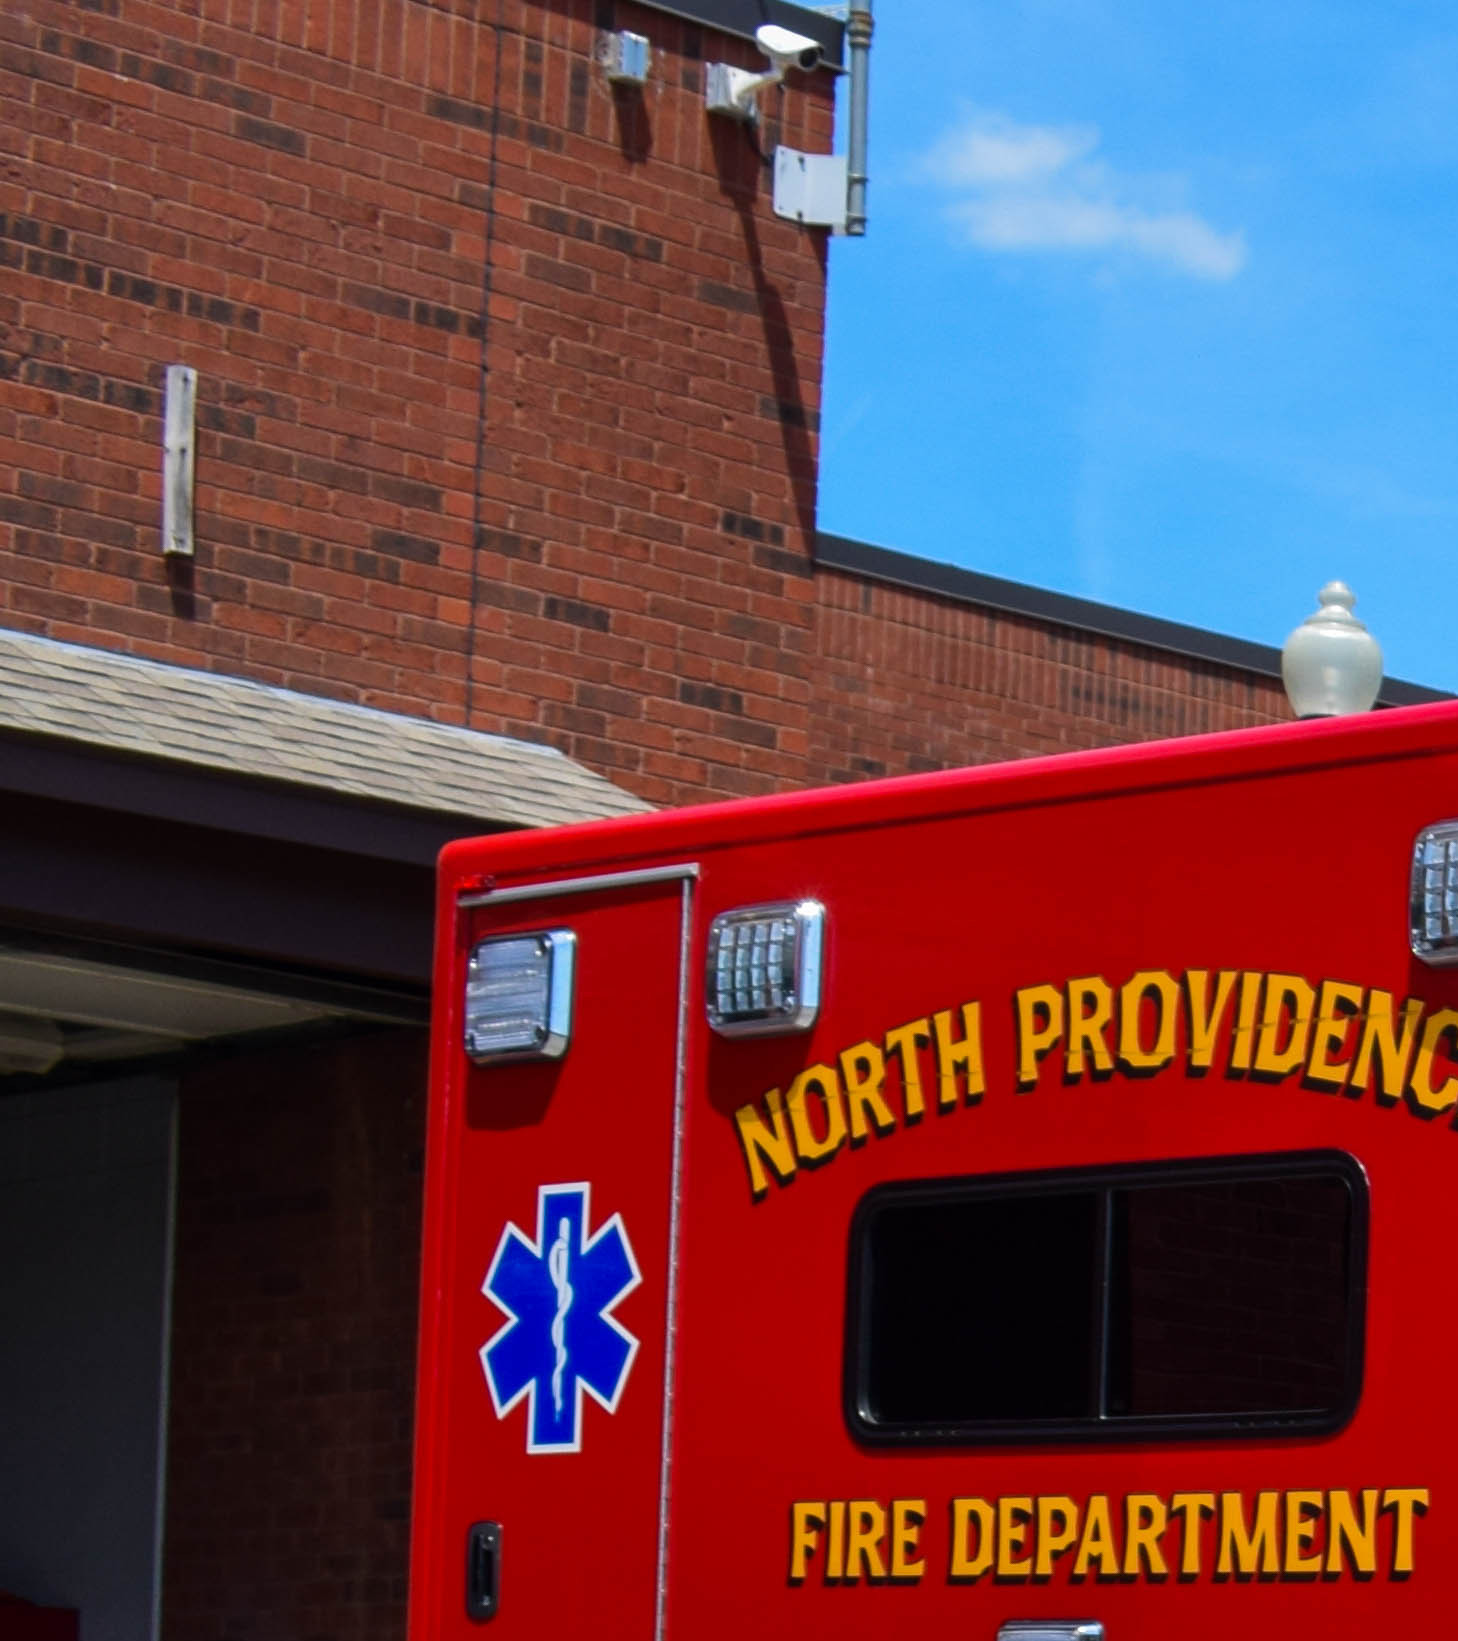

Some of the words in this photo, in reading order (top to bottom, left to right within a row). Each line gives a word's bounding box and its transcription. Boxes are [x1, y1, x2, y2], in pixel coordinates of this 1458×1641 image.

[734, 1001, 988, 1202] NORTH
[788, 1499, 926, 1587] FIRE
[946, 1488, 1430, 1586] DEPARTMENT
